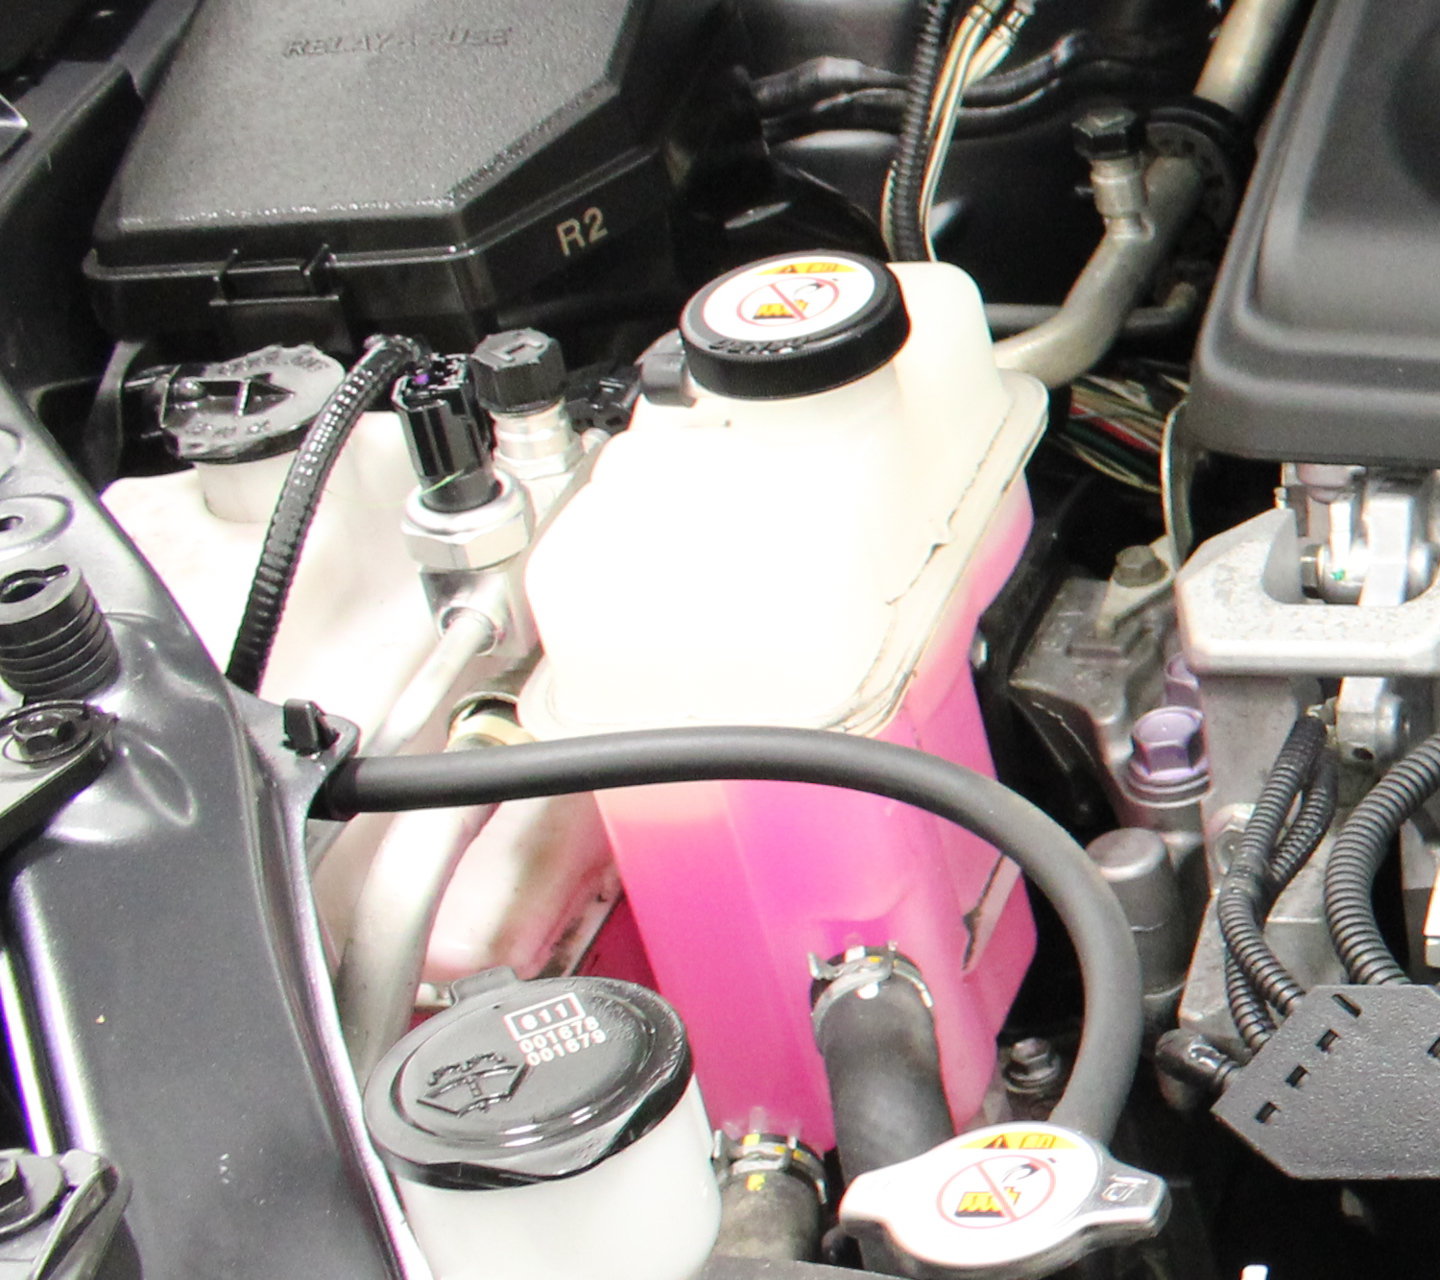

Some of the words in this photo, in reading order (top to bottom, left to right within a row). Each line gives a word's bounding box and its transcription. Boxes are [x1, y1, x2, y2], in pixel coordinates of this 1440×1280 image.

[556, 207, 609, 257] R2
[518, 1015, 600, 1054] 001678
[525, 1028, 608, 1067] 001679
